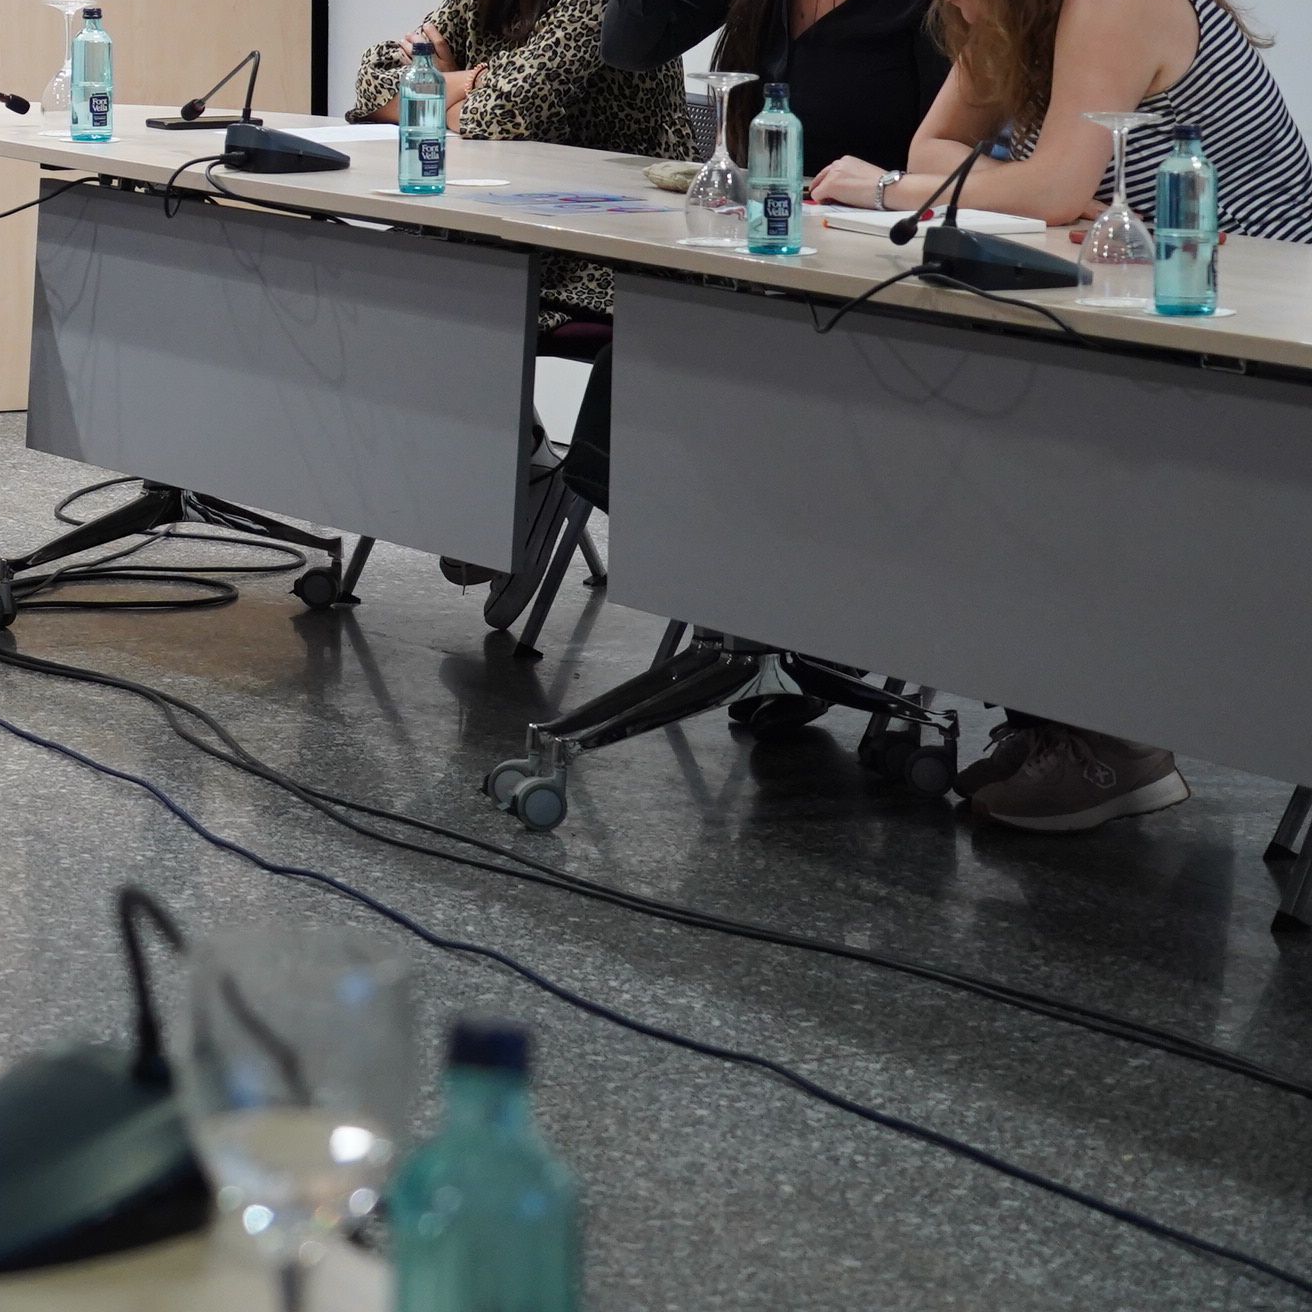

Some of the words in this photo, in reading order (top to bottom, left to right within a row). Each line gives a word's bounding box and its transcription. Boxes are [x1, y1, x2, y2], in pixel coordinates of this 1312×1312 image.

[92, 97, 108, 105] Font
[92, 103, 108, 112] Vella
[421, 143, 439, 152] Font
[421, 151, 440, 160] Vella
[767, 198, 789, 208] Font
[766, 207, 790, 217] Vella
